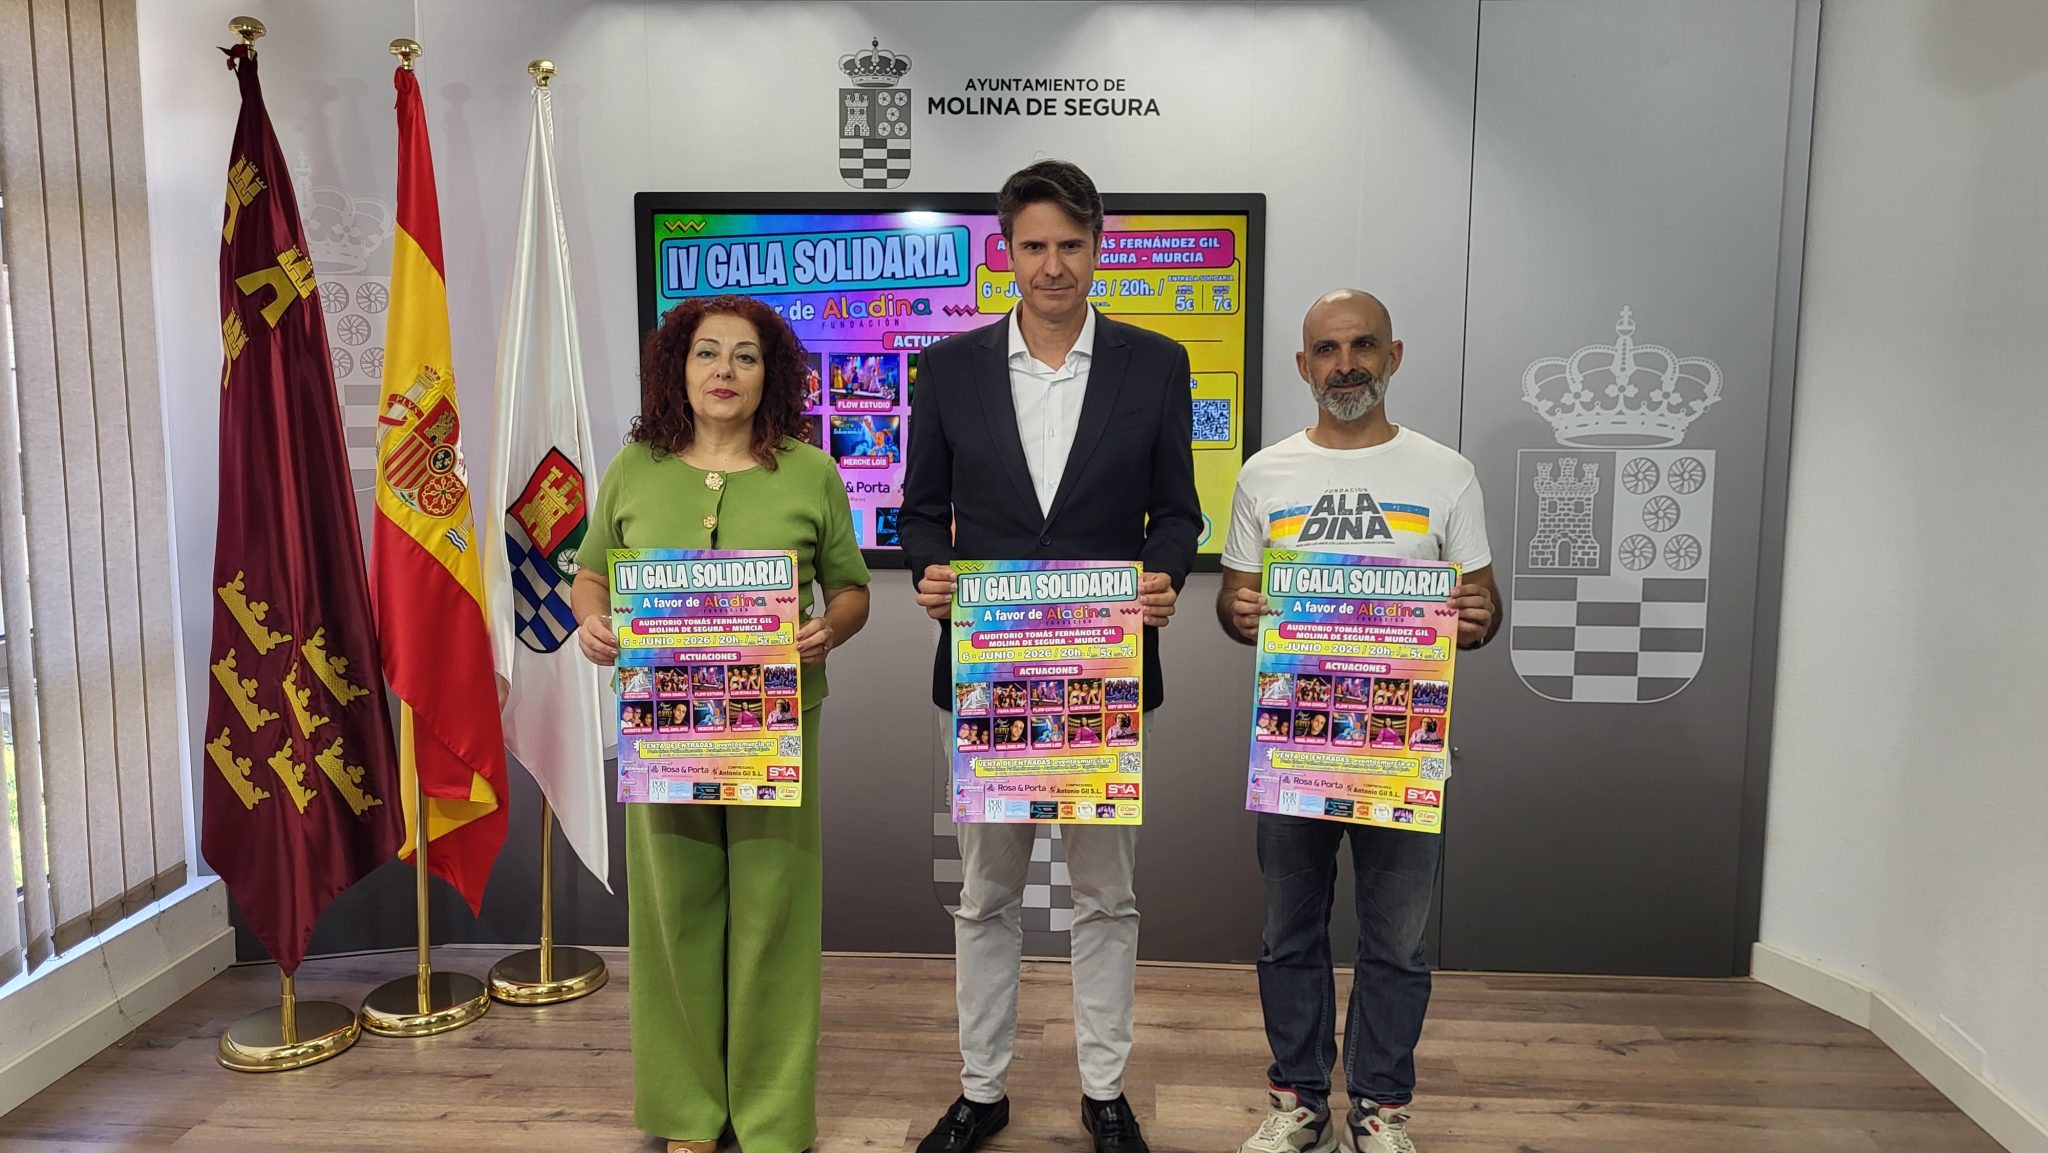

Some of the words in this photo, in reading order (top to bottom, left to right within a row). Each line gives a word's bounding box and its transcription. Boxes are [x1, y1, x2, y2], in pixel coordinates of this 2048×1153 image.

[965, 79, 1098, 92] AYUNTAMIENTO
[1104, 79, 1125, 92] DE
[928, 97, 1020, 115] MOLINA
[1026, 98, 1056, 115] DE
[1064, 98, 1160, 116] SEGURA
[1100, 236, 1116, 249] ÁS
[1120, 235, 1196, 249] FERNÁNDEZ
[1199, 236, 1220, 248] GIL
[668, 246, 699, 290] IV
[706, 240, 787, 288] GALA
[794, 233, 959, 284] SOLIDARIA
[1098, 252, 1137, 264] GURA
[1152, 252, 1204, 264] MURCIA
[982, 282, 992, 298] 6
[1088, 280, 1107, 296] 26
[1120, 279, 1154, 297] 20h.
[789, 299, 815, 321] de
[822, 294, 933, 321] Aladina
[1175, 296, 1194, 311] 5€
[1212, 296, 1232, 311] 7€
[857, 482, 890, 493] Porta
[1311, 494, 1381, 516] ALA
[1298, 516, 1393, 542] DINA
[619, 565, 638, 590] IV
[642, 563, 689, 589] GALA
[692, 559, 788, 588] SOLIDARIA
[962, 577, 981, 602] IV
[985, 575, 1032, 601] GALA
[1036, 570, 1133, 599] SOLIDARIA
[1273, 568, 1294, 592] IV
[1297, 568, 1344, 594] GALA
[1350, 569, 1450, 596] SOLIDARIA
[643, 598, 650, 608] A
[654, 597, 682, 608] favor
[686, 597, 699, 607] de
[704, 595, 766, 608] Aladina
[984, 611, 992, 621] A
[996, 609, 1025, 620] favor
[1028, 609, 1042, 620] de
[1047, 607, 1110, 620] Aladina
[1293, 602, 1302, 612] A
[1306, 601, 1336, 613] favor
[1339, 602, 1354, 614] de
[1358, 603, 1424, 617] Aladina
[1055, 629, 1100, 637] FERNÁNDEZ
[1334, 625, 1363, 633] TOMÁS
[1365, 626, 1412, 635] FERNÁNDEZ
[640, 637, 674, 645] JUNIO
[719, 636, 741, 644] 20h.
[963, 652, 969, 660] 6
[980, 651, 1014, 660] JUNIO
[1062, 649, 1085, 657] 20h.
[1285, 643, 1321, 651] JUNIO
[1332, 645, 1360, 654] 2026
[1370, 646, 1394, 655] 20h.
[1020, 667, 1078, 675] ACTUACIONES
[1325, 663, 1386, 672] ACTUACIONES
[1294, 777, 1312, 786] Rosa
[1321, 779, 1343, 789] Porta
[1353, 787, 1378, 795] Antonio
